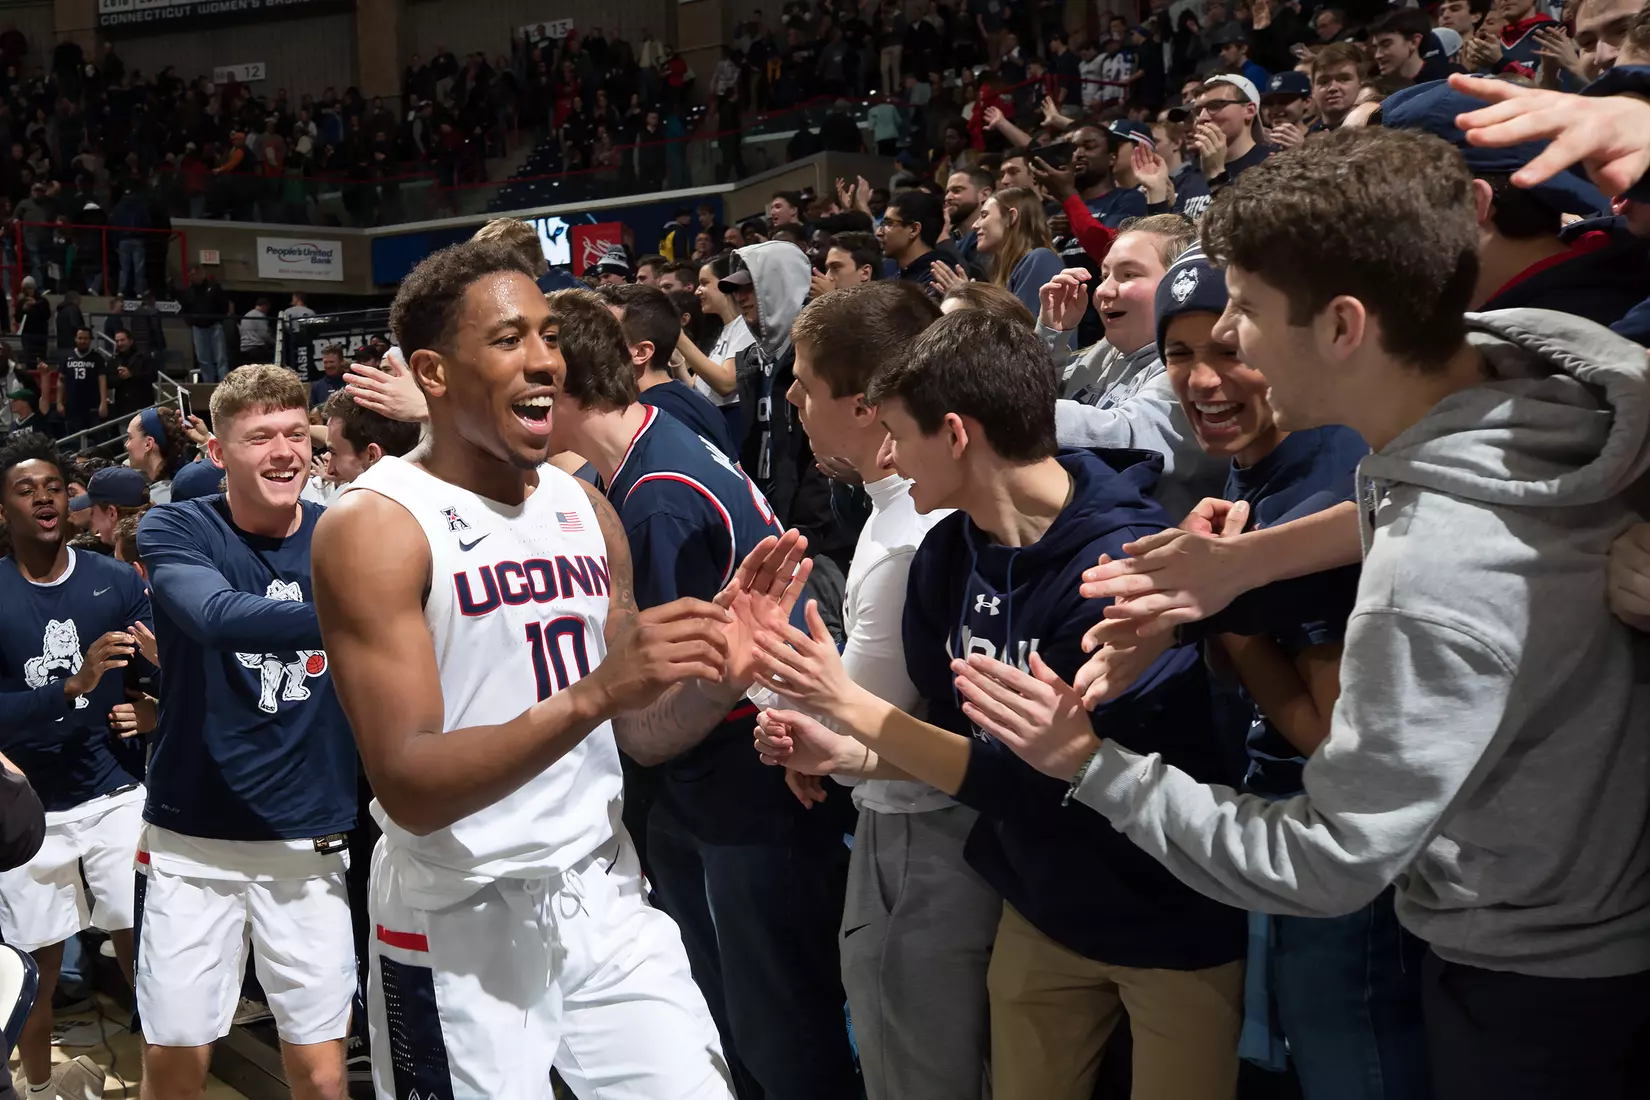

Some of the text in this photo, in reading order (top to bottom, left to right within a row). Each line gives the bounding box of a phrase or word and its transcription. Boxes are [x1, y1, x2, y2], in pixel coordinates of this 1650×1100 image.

[100, 5, 191, 26] CONNECTICUT
[245, 66, 260, 78] 12
[265, 245, 333, 258] People's United
[310, 256, 332, 265] Bank
[75, 368, 86, 379] 13
[453, 555, 610, 616] UCONN
[525, 615, 591, 703] 10
